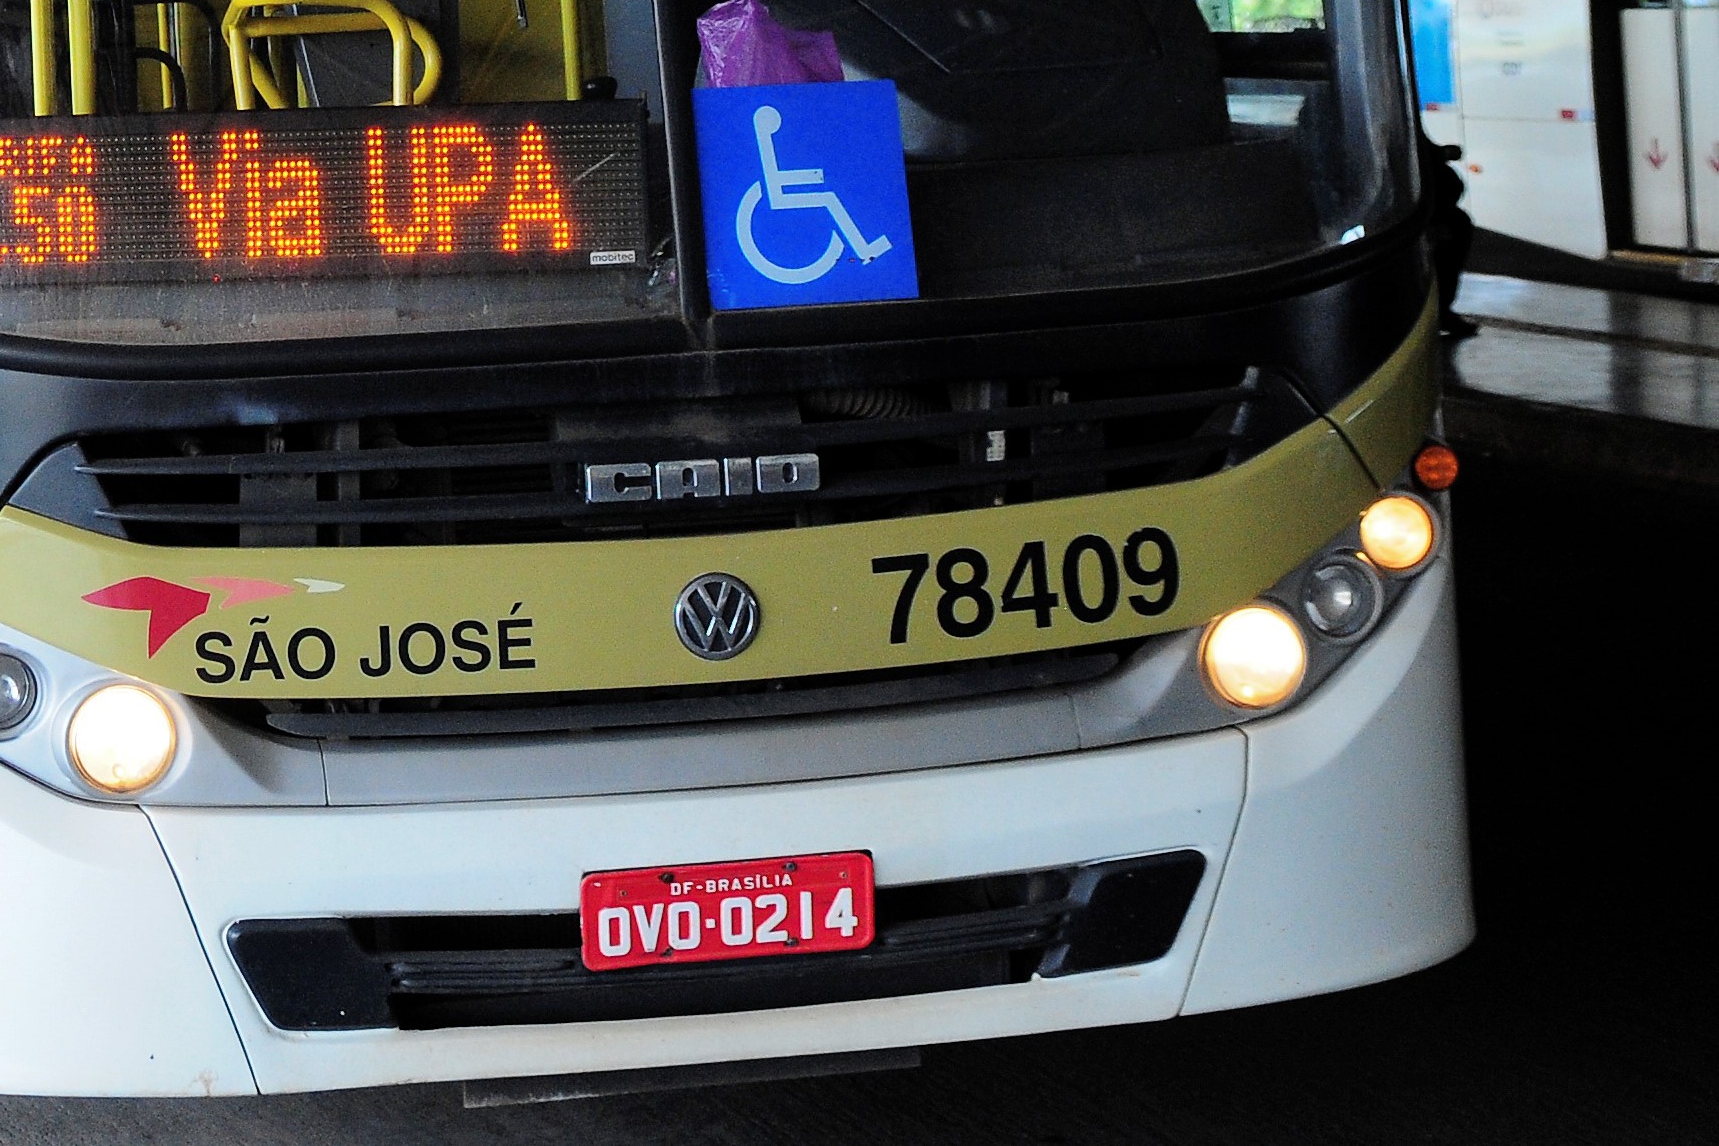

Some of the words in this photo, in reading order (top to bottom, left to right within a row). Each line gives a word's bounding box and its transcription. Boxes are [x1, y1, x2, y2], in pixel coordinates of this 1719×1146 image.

[171, 130, 322, 259] Via
[367, 122, 571, 254] UPA
[592, 252, 634, 262] mobitec
[585, 453, 820, 502] CAIO
[872, 525, 1180, 645] 78409
[194, 615, 336, 684] SÃO
[359, 602, 536, 677] JOSÉ
